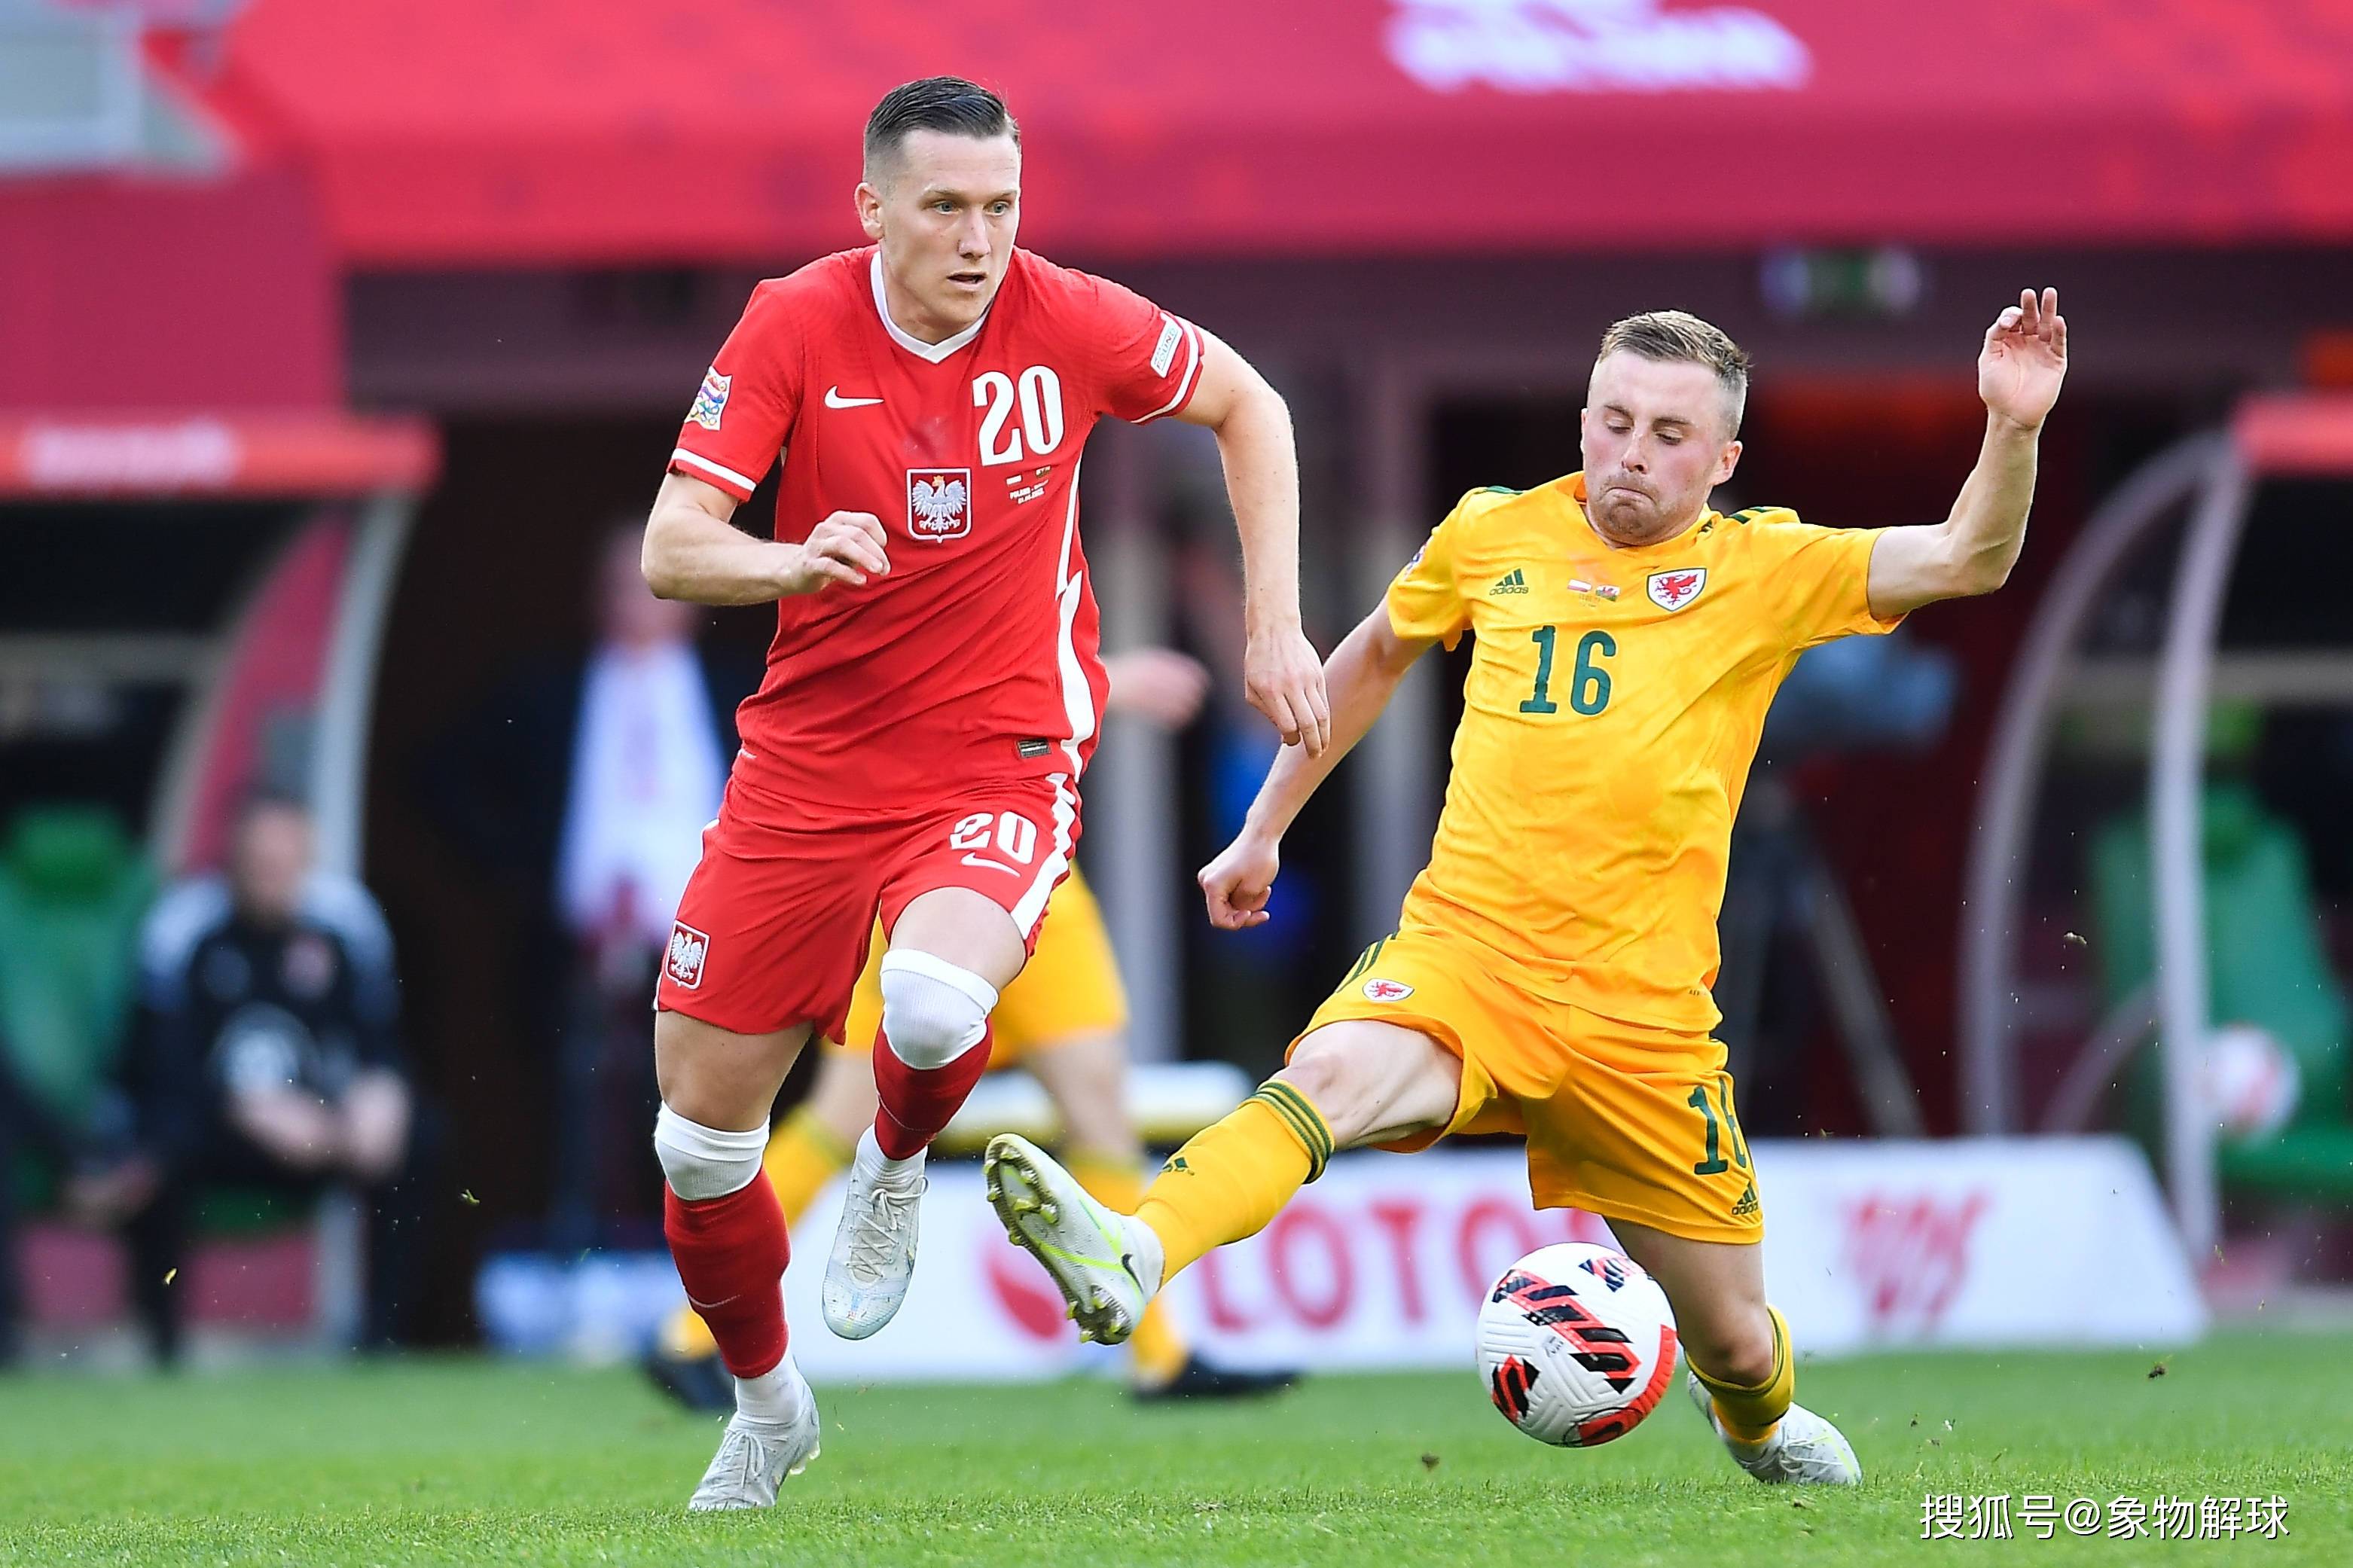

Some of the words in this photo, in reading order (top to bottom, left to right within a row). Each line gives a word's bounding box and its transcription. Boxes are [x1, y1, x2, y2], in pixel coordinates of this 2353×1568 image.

[972, 365, 1064, 466] 20
[1489, 585, 1529, 596] adidas
[1519, 625, 1616, 715] 16
[950, 810, 1038, 865] 20
[1198, 1192, 1610, 1332] LOTO
